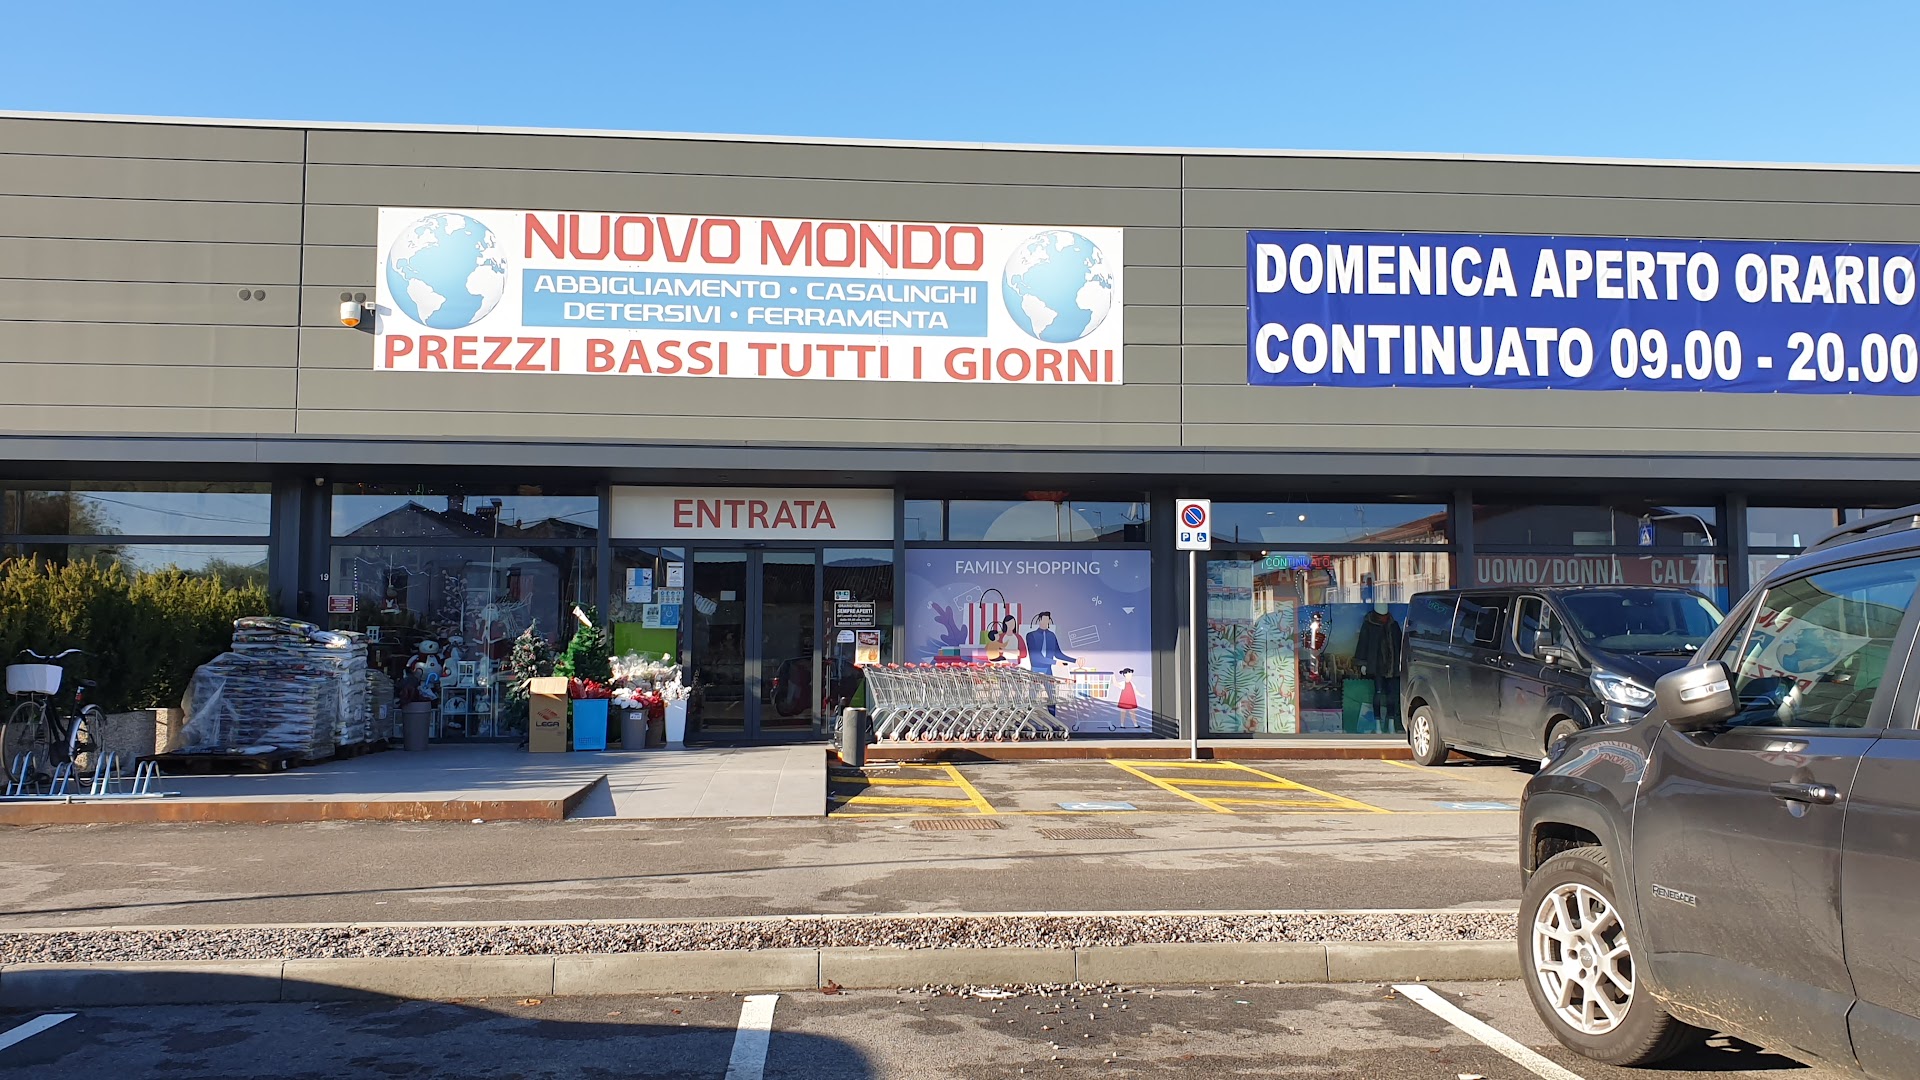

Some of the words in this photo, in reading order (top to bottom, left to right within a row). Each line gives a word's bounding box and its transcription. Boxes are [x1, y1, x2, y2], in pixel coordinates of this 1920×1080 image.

[525, 213, 741, 265] NUOVO
[761, 220, 984, 271] MONDO
[533, 274, 781, 299] ABBIGLIAMENTO
[806, 282, 977, 304] CASALINGHI
[1255, 243, 1518, 297] DOMENICA
[1530, 250, 1719, 302] APERTO
[1734, 253, 1916, 306] ORARIO
[563, 301, 721, 323] DETERSIVI
[747, 306, 949, 329] FERRAMENTA
[384, 334, 561, 372] PREZZI
[586, 338, 728, 375] BASSI
[748, 342, 889, 379] TUTTI
[913, 346, 923, 380] I
[944, 347, 1114, 383] GIORNI
[1255, 323, 1594, 378] CONTINUATO
[1610, 328, 1742, 380] 09.00
[1787, 331, 1919, 384] 20.00
[674, 500, 836, 529] ENTRATA
[320, 573, 329, 581] 19
[955, 560, 1012, 574] FAMILY
[1016, 560, 1101, 575] SHOPPING
[1477, 558, 1625, 584] UOMO/DONNA
[1652, 884, 1696, 906] RENEGADE
